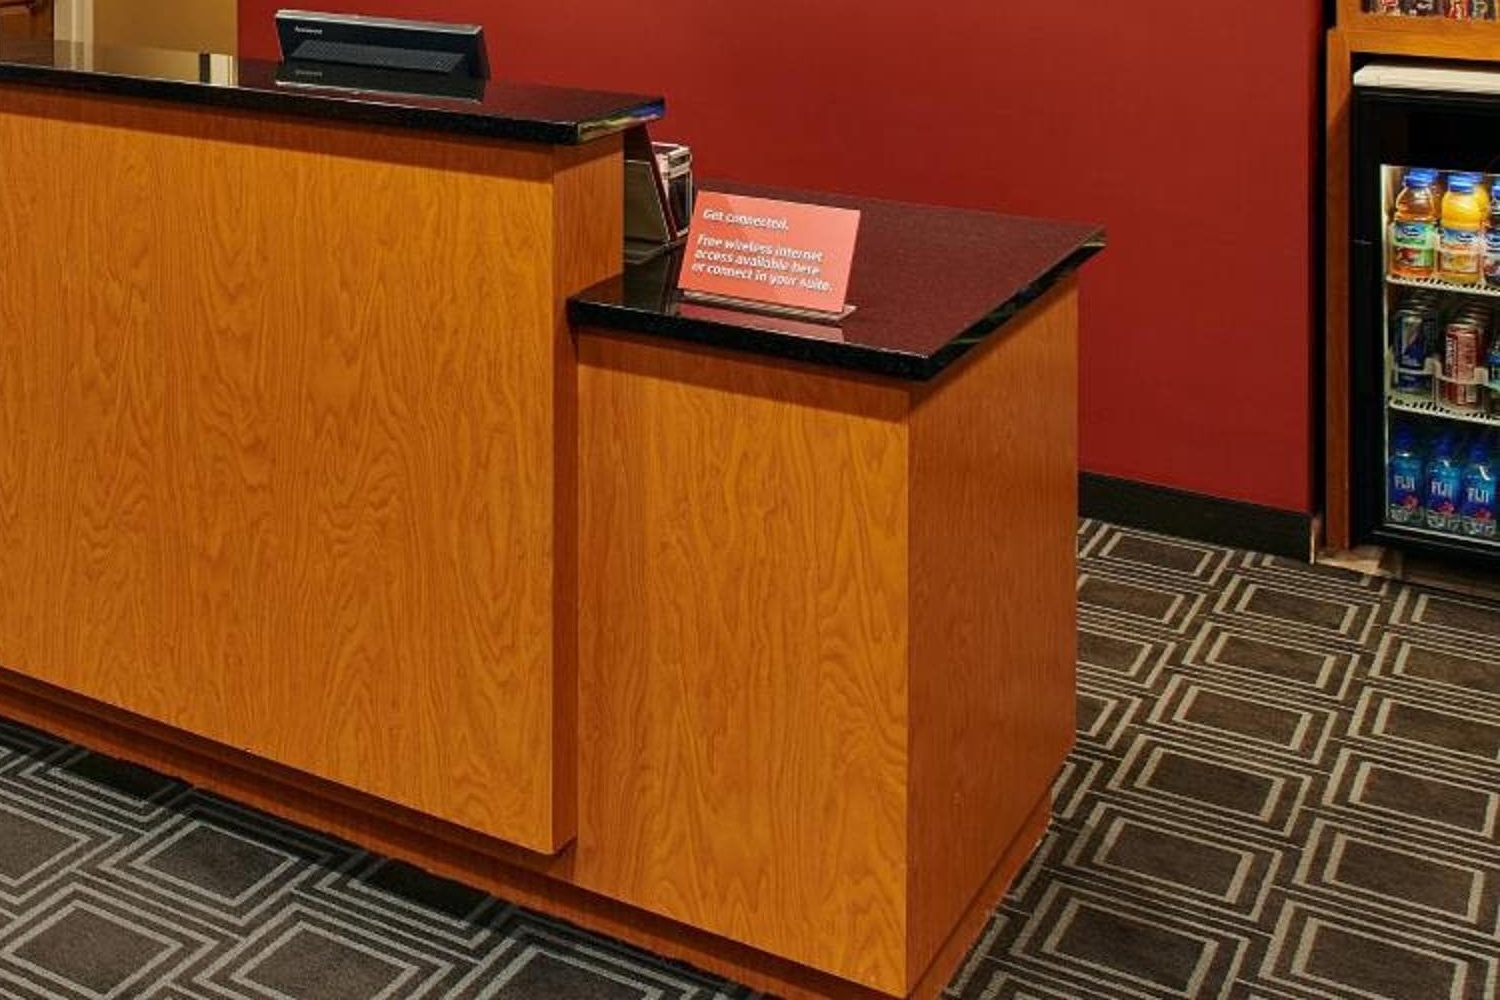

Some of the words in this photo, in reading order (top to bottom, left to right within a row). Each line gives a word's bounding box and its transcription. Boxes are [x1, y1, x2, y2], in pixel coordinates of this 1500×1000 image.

[703, 209, 724, 222] Get
[726, 213, 789, 231] connected.
[695, 249, 733, 262] access
[737, 254, 790, 270] available
[697, 233, 723, 246] Free
[725, 239, 773, 255] wireless
[775, 244, 823, 262] internet
[691, 263, 704, 273] or
[707, 264, 753, 281] connect
[755, 270, 767, 281] in
[770, 275, 798, 288] your
[799, 279, 834, 293] suite.
